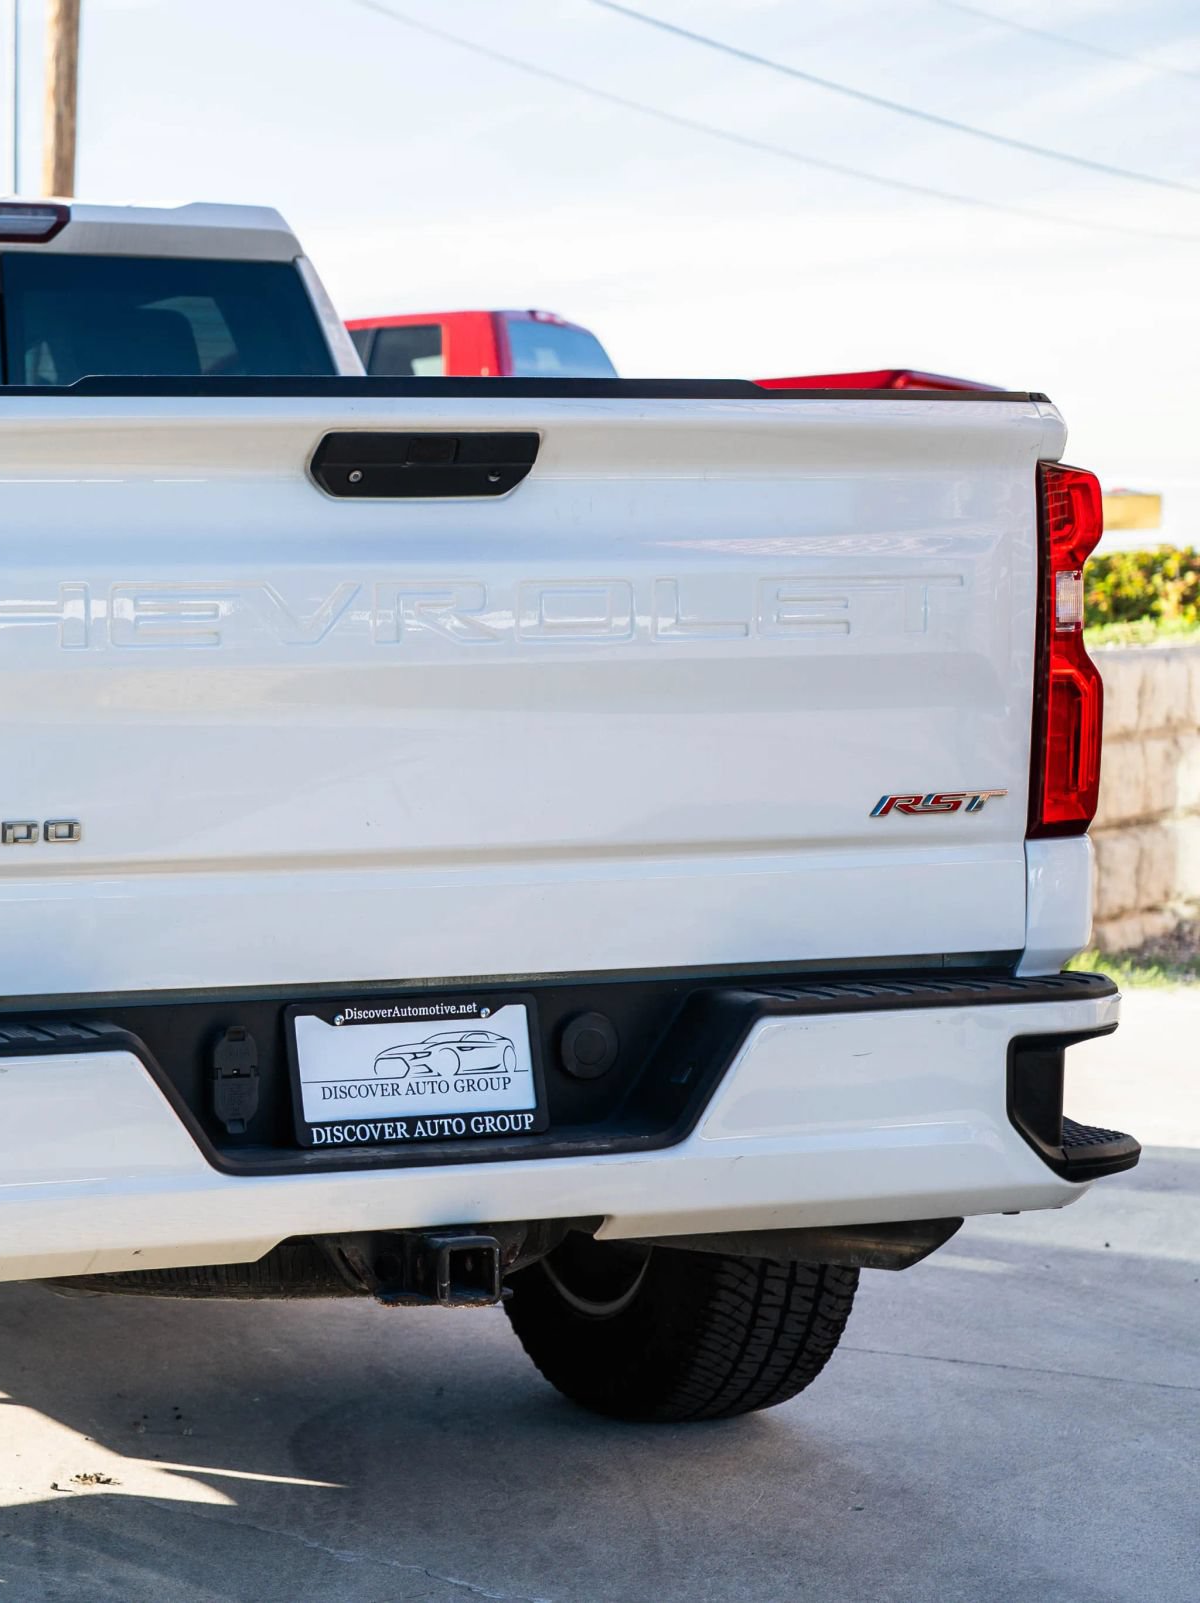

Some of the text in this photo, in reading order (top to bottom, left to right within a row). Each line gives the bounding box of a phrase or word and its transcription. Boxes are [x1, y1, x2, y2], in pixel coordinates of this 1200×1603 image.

[869, 788, 1009, 817] RST
[344, 1001, 477, 1021] DiscoverAutomotive.net
[321, 1077, 512, 1101] DISCOVER AUTO GROUP
[311, 1113, 535, 1145] DISCOVER AUTO GROUP
